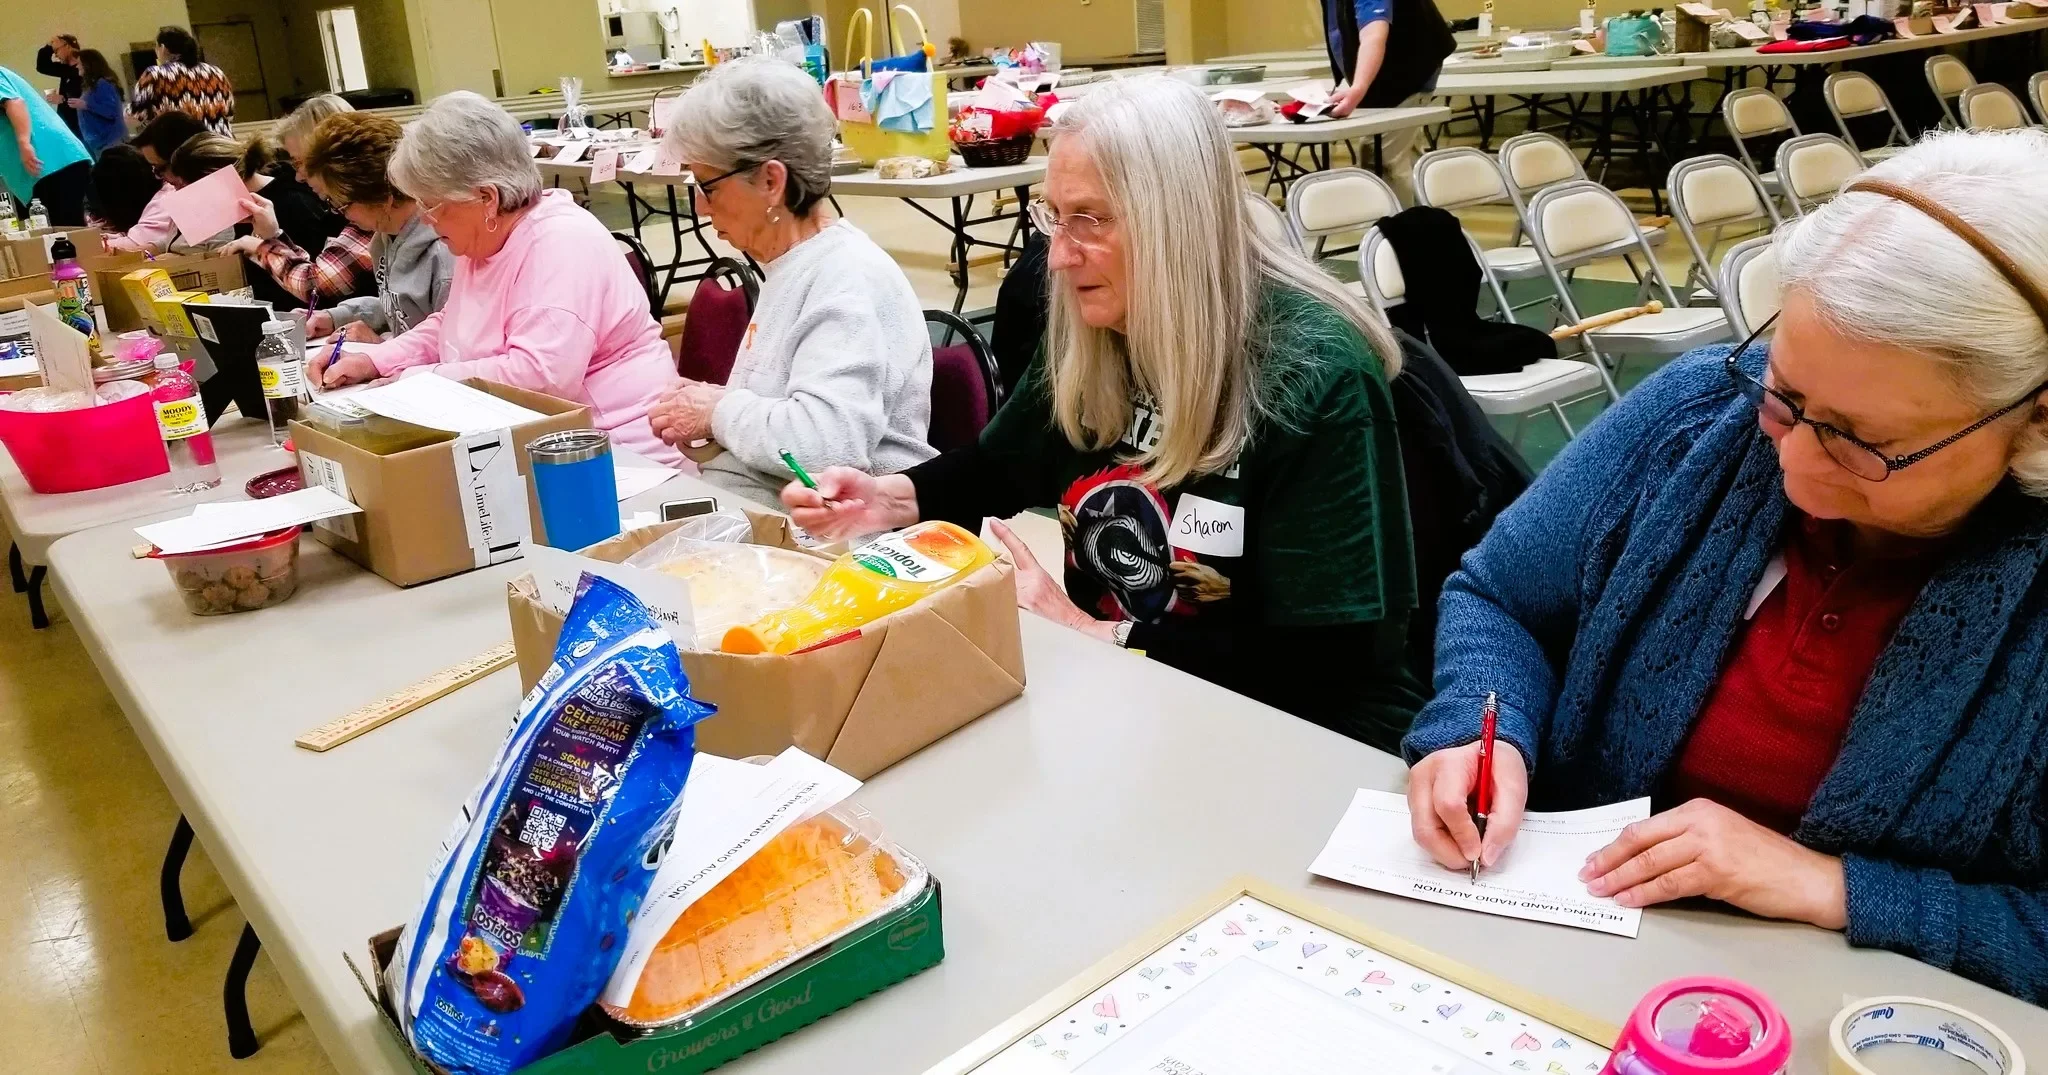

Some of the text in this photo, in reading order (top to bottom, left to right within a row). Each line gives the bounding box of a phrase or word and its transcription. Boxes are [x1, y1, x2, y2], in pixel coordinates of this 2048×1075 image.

[163, 404, 193, 415] MOODY
[475, 485, 493, 537] LimeLife
[1181, 508, 1235, 539] Sharon
[581, 687, 608, 707] SUPER
[581, 704, 597, 715] NOW
[559, 714, 580, 729] LIKE
[588, 724, 626, 742] CHAMP
[564, 704, 631, 734] CELEBRATE
[552, 726, 620, 755] YOUR WATCH PARTY!
[589, 733, 606, 742] FROM
[553, 759, 574, 770] CHANCE
[581, 769, 591, 777] GET
[560, 752, 590, 769] SCAN
[529, 773, 578, 796] CELEBRATION
[532, 766, 549, 777] TASTE
[551, 773, 561, 781] OF
[561, 777, 580, 788] SUPER
[522, 787, 535, 795] AND
[545, 794, 556, 802] THE
[555, 798, 580, 812] CONFETTI
[580, 807, 591, 815] FLY!
[540, 786, 552, 794] ON
[553, 789, 578, 804] 1.25.24
[668, 782, 820, 899] HELPING HAND RADIO AUCTION
[1413, 883, 1624, 922] HELPING HAND RADIO AUCTION
[648, 1022, 740, 1073] Growers
[757, 980, 815, 1024] Good
